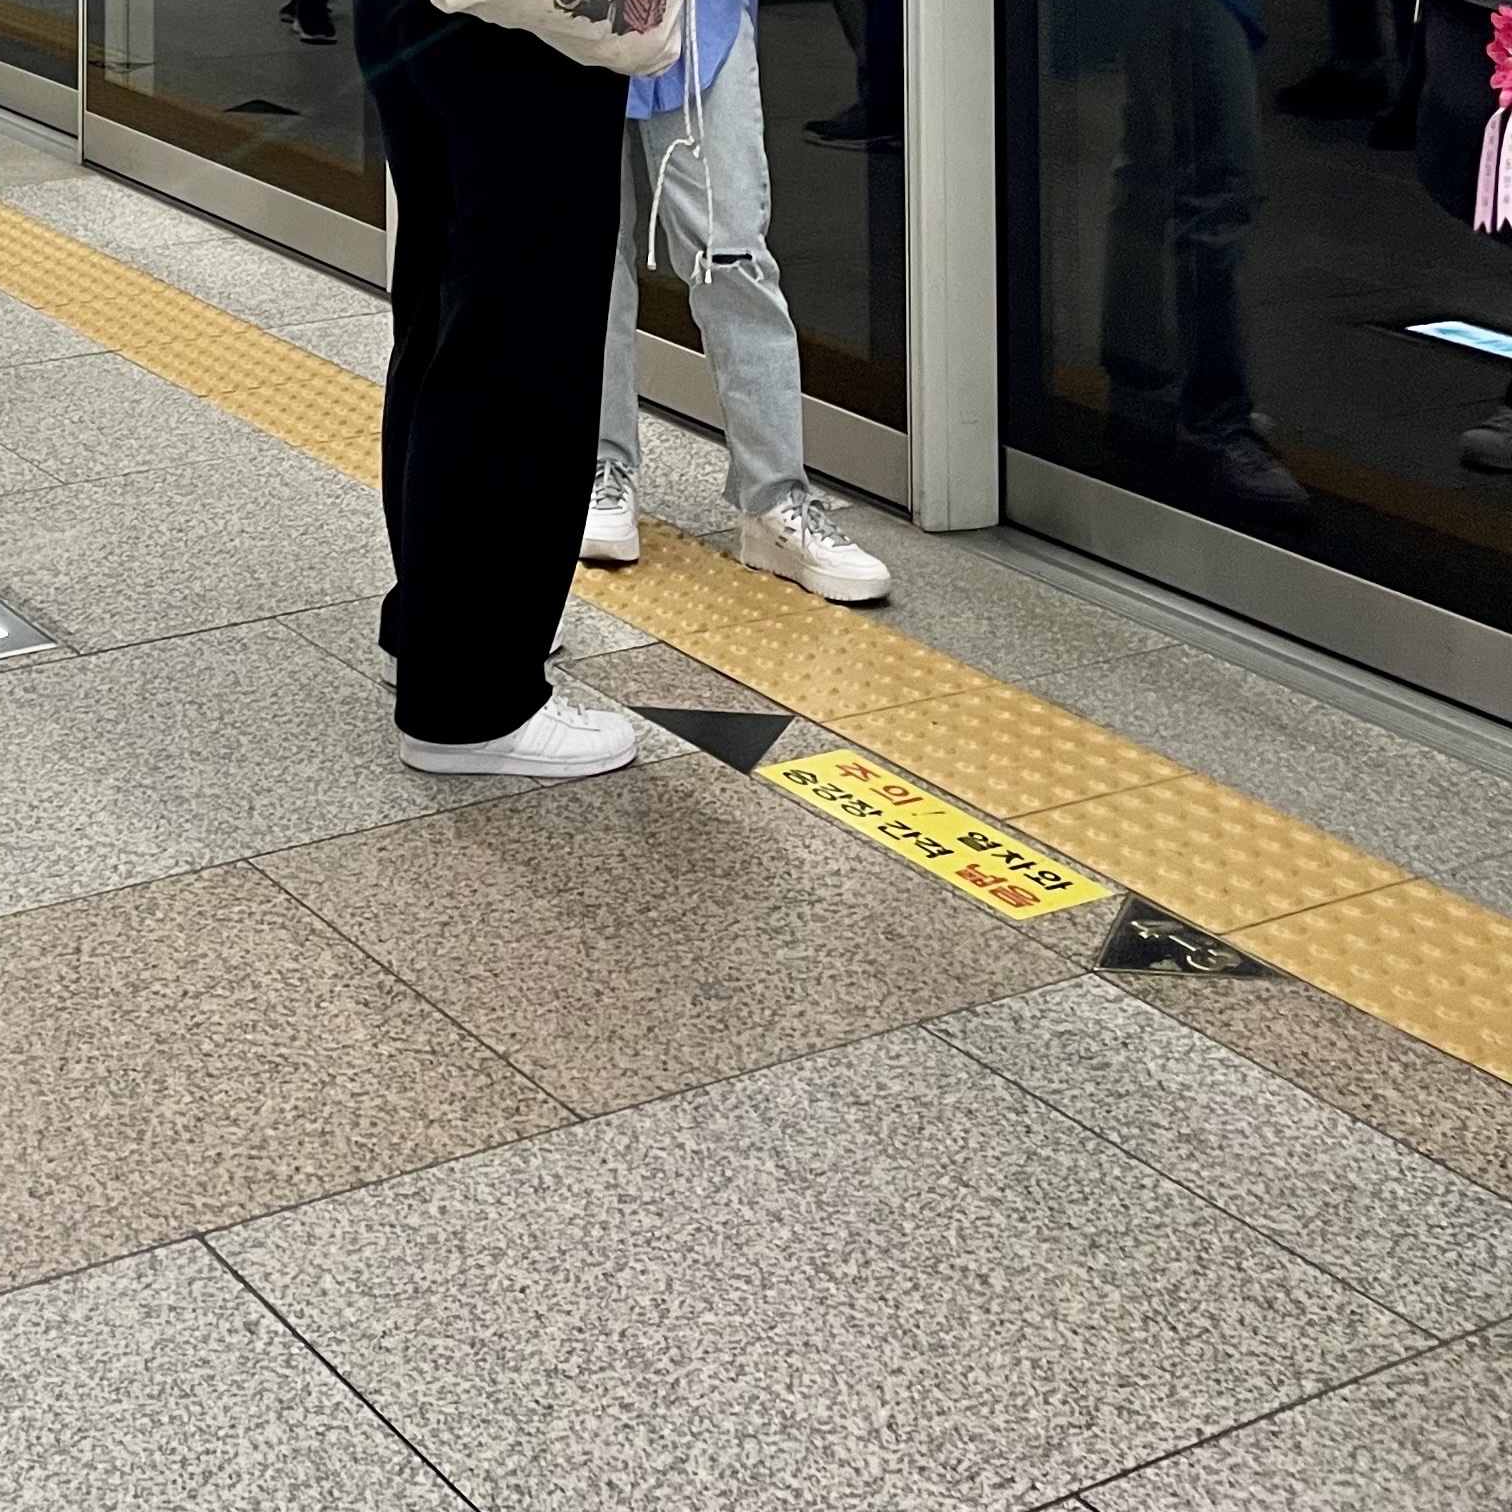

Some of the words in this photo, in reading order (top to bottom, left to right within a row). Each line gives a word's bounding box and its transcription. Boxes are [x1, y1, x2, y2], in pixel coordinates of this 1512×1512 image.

[782, 768, 884, 818] 승강장
[878, 820, 955, 859] 간격
[955, 863, 1042, 909] 넓음
[956, 831, 1075, 892] 열차와
